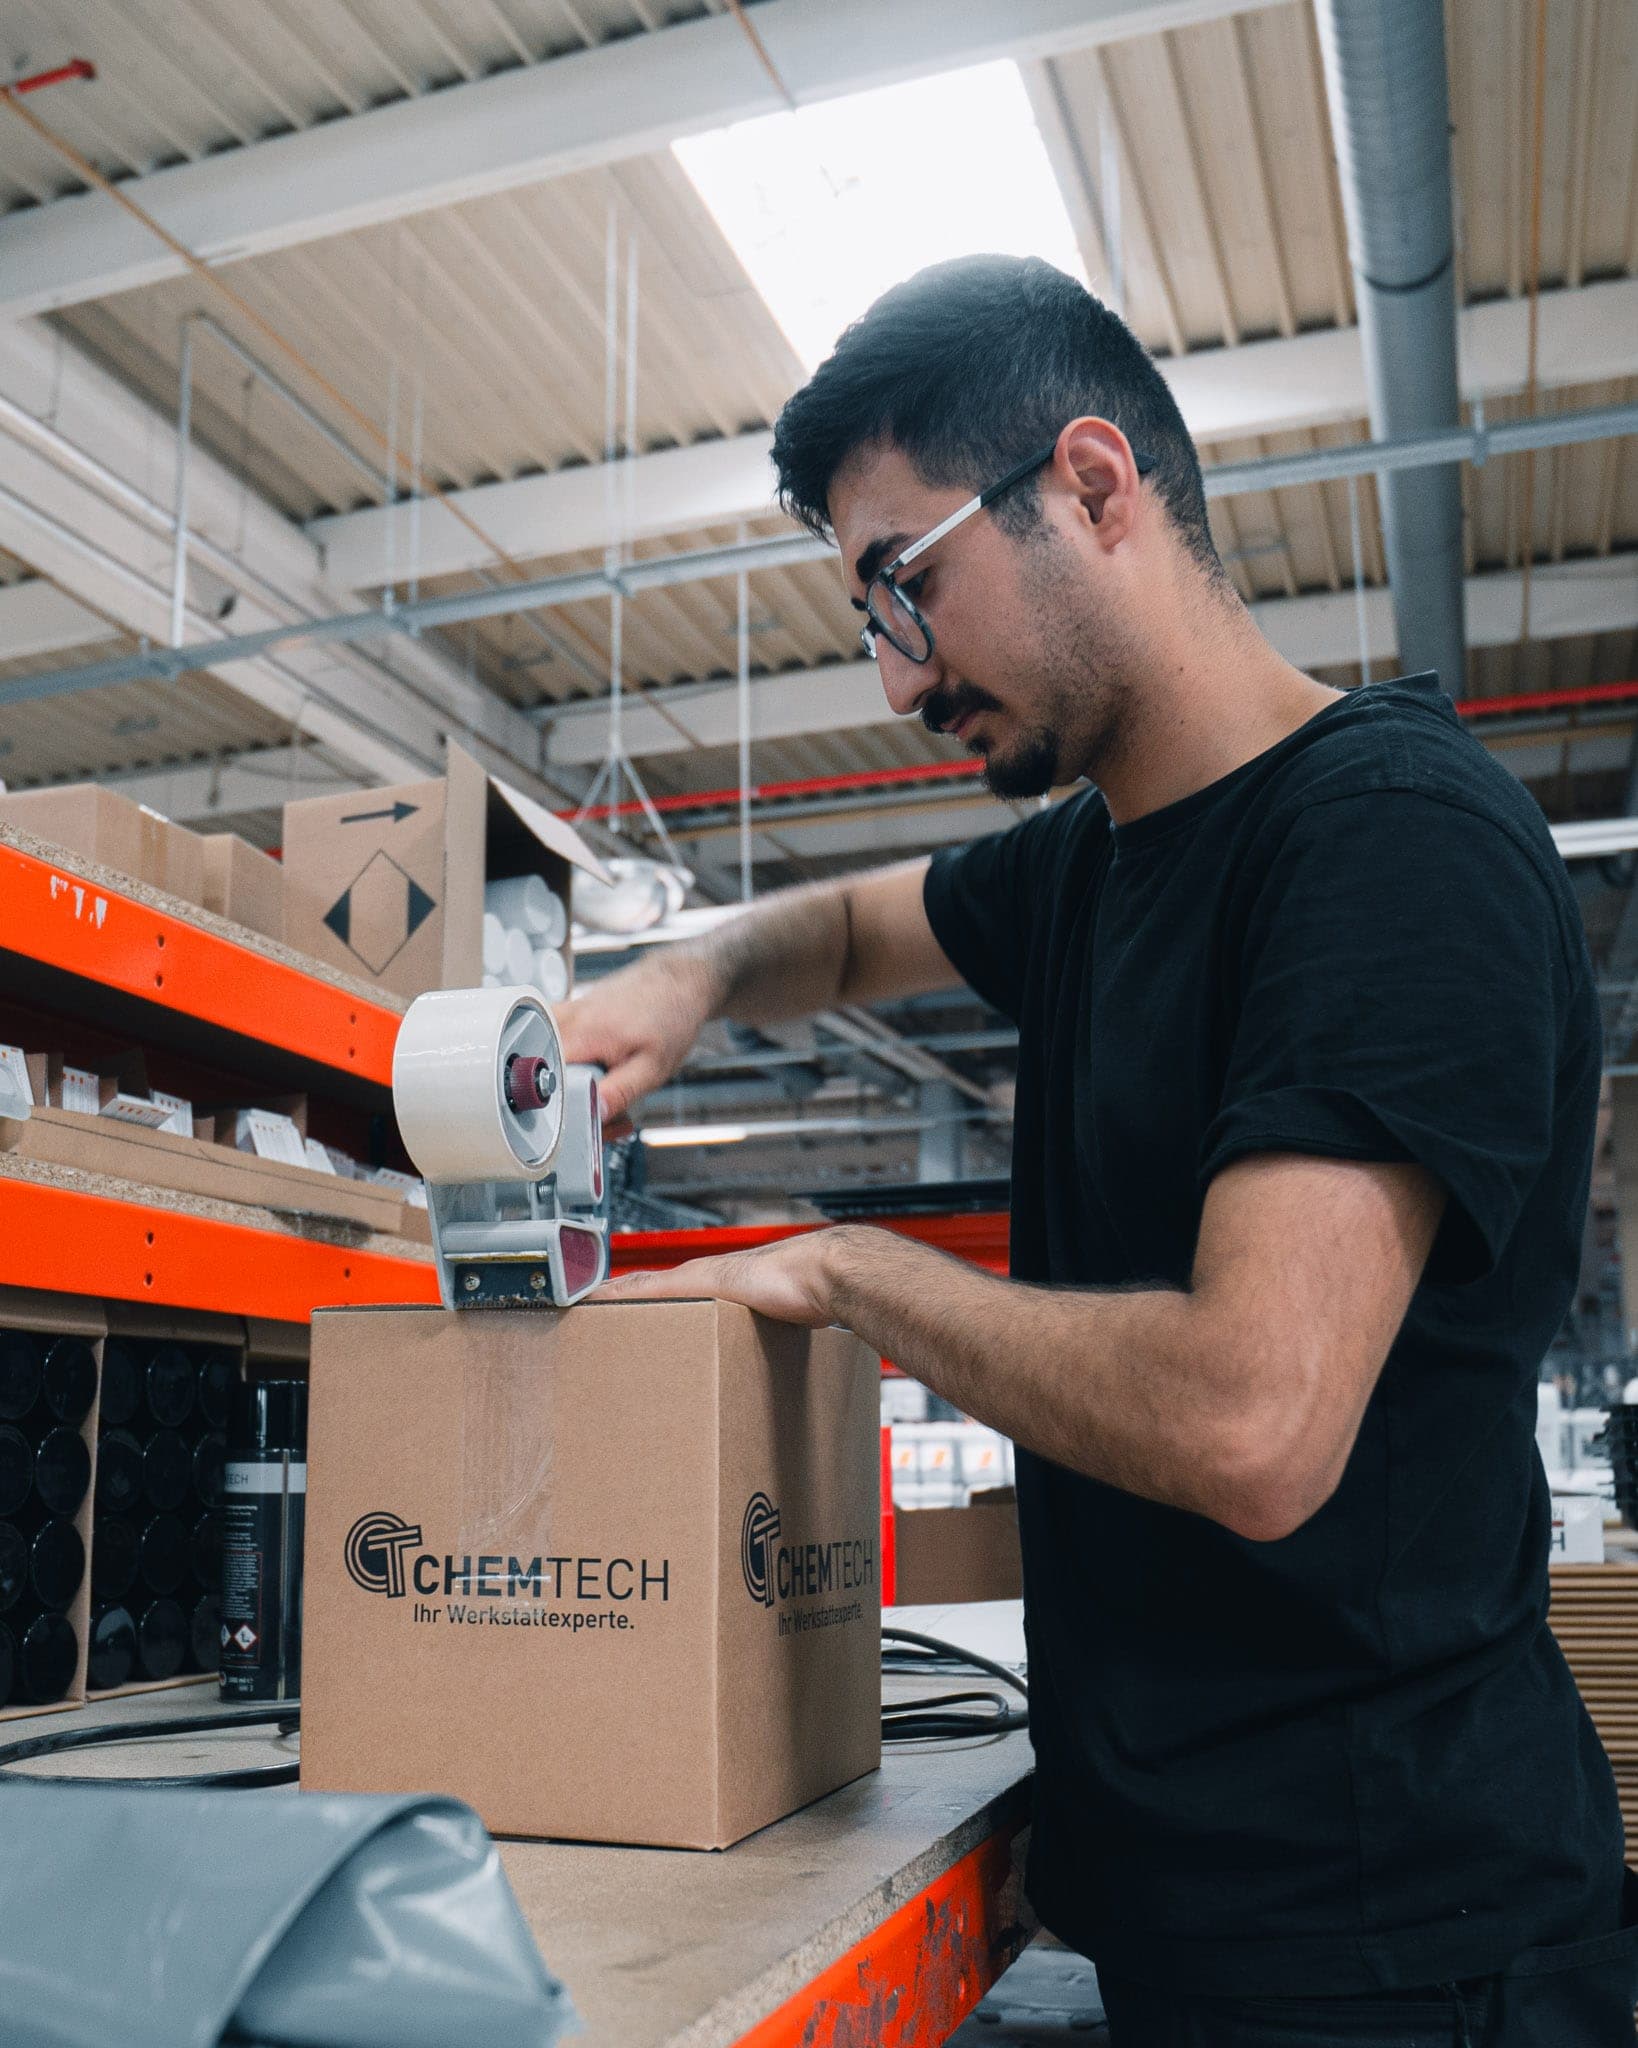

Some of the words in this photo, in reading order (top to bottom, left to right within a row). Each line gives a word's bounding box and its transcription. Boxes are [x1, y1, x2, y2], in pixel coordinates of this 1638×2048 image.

[413, 1554, 669, 1601] CHEMTECH
[777, 1539, 873, 1599] CHEMTECH
[414, 1604, 441, 1623] Ihr
[447, 1605, 635, 1632] Werkstattexperte.
[778, 1611, 791, 1637] Ihr
